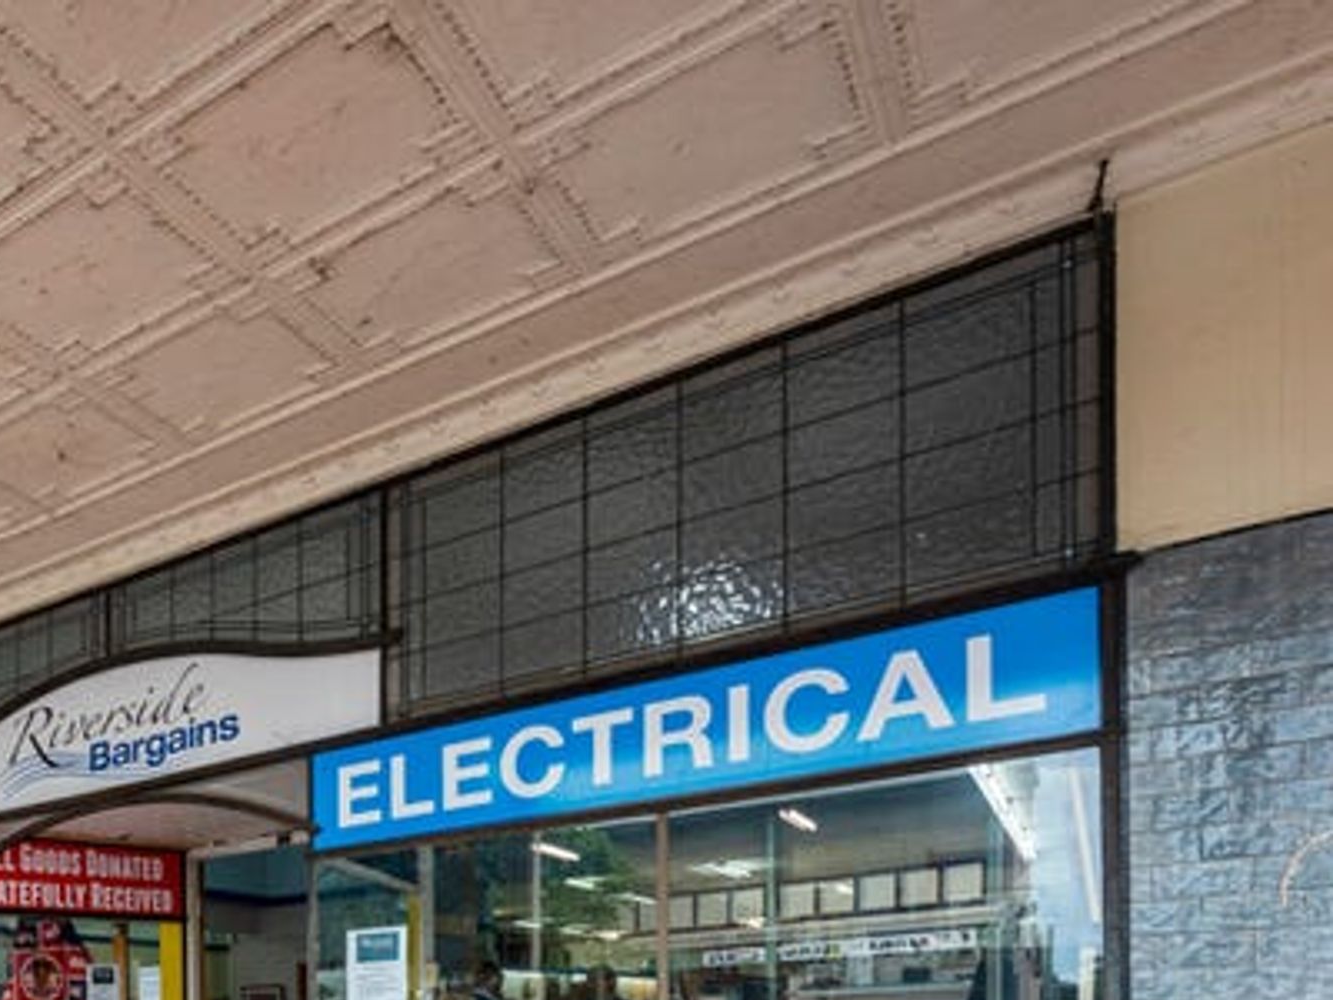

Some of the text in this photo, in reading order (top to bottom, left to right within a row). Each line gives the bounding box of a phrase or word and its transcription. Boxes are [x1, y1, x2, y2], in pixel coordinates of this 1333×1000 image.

[8, 662, 204, 768] Riverside
[88, 712, 241, 772] Bargains
[337, 634, 1048, 828] ELECTRICAL
